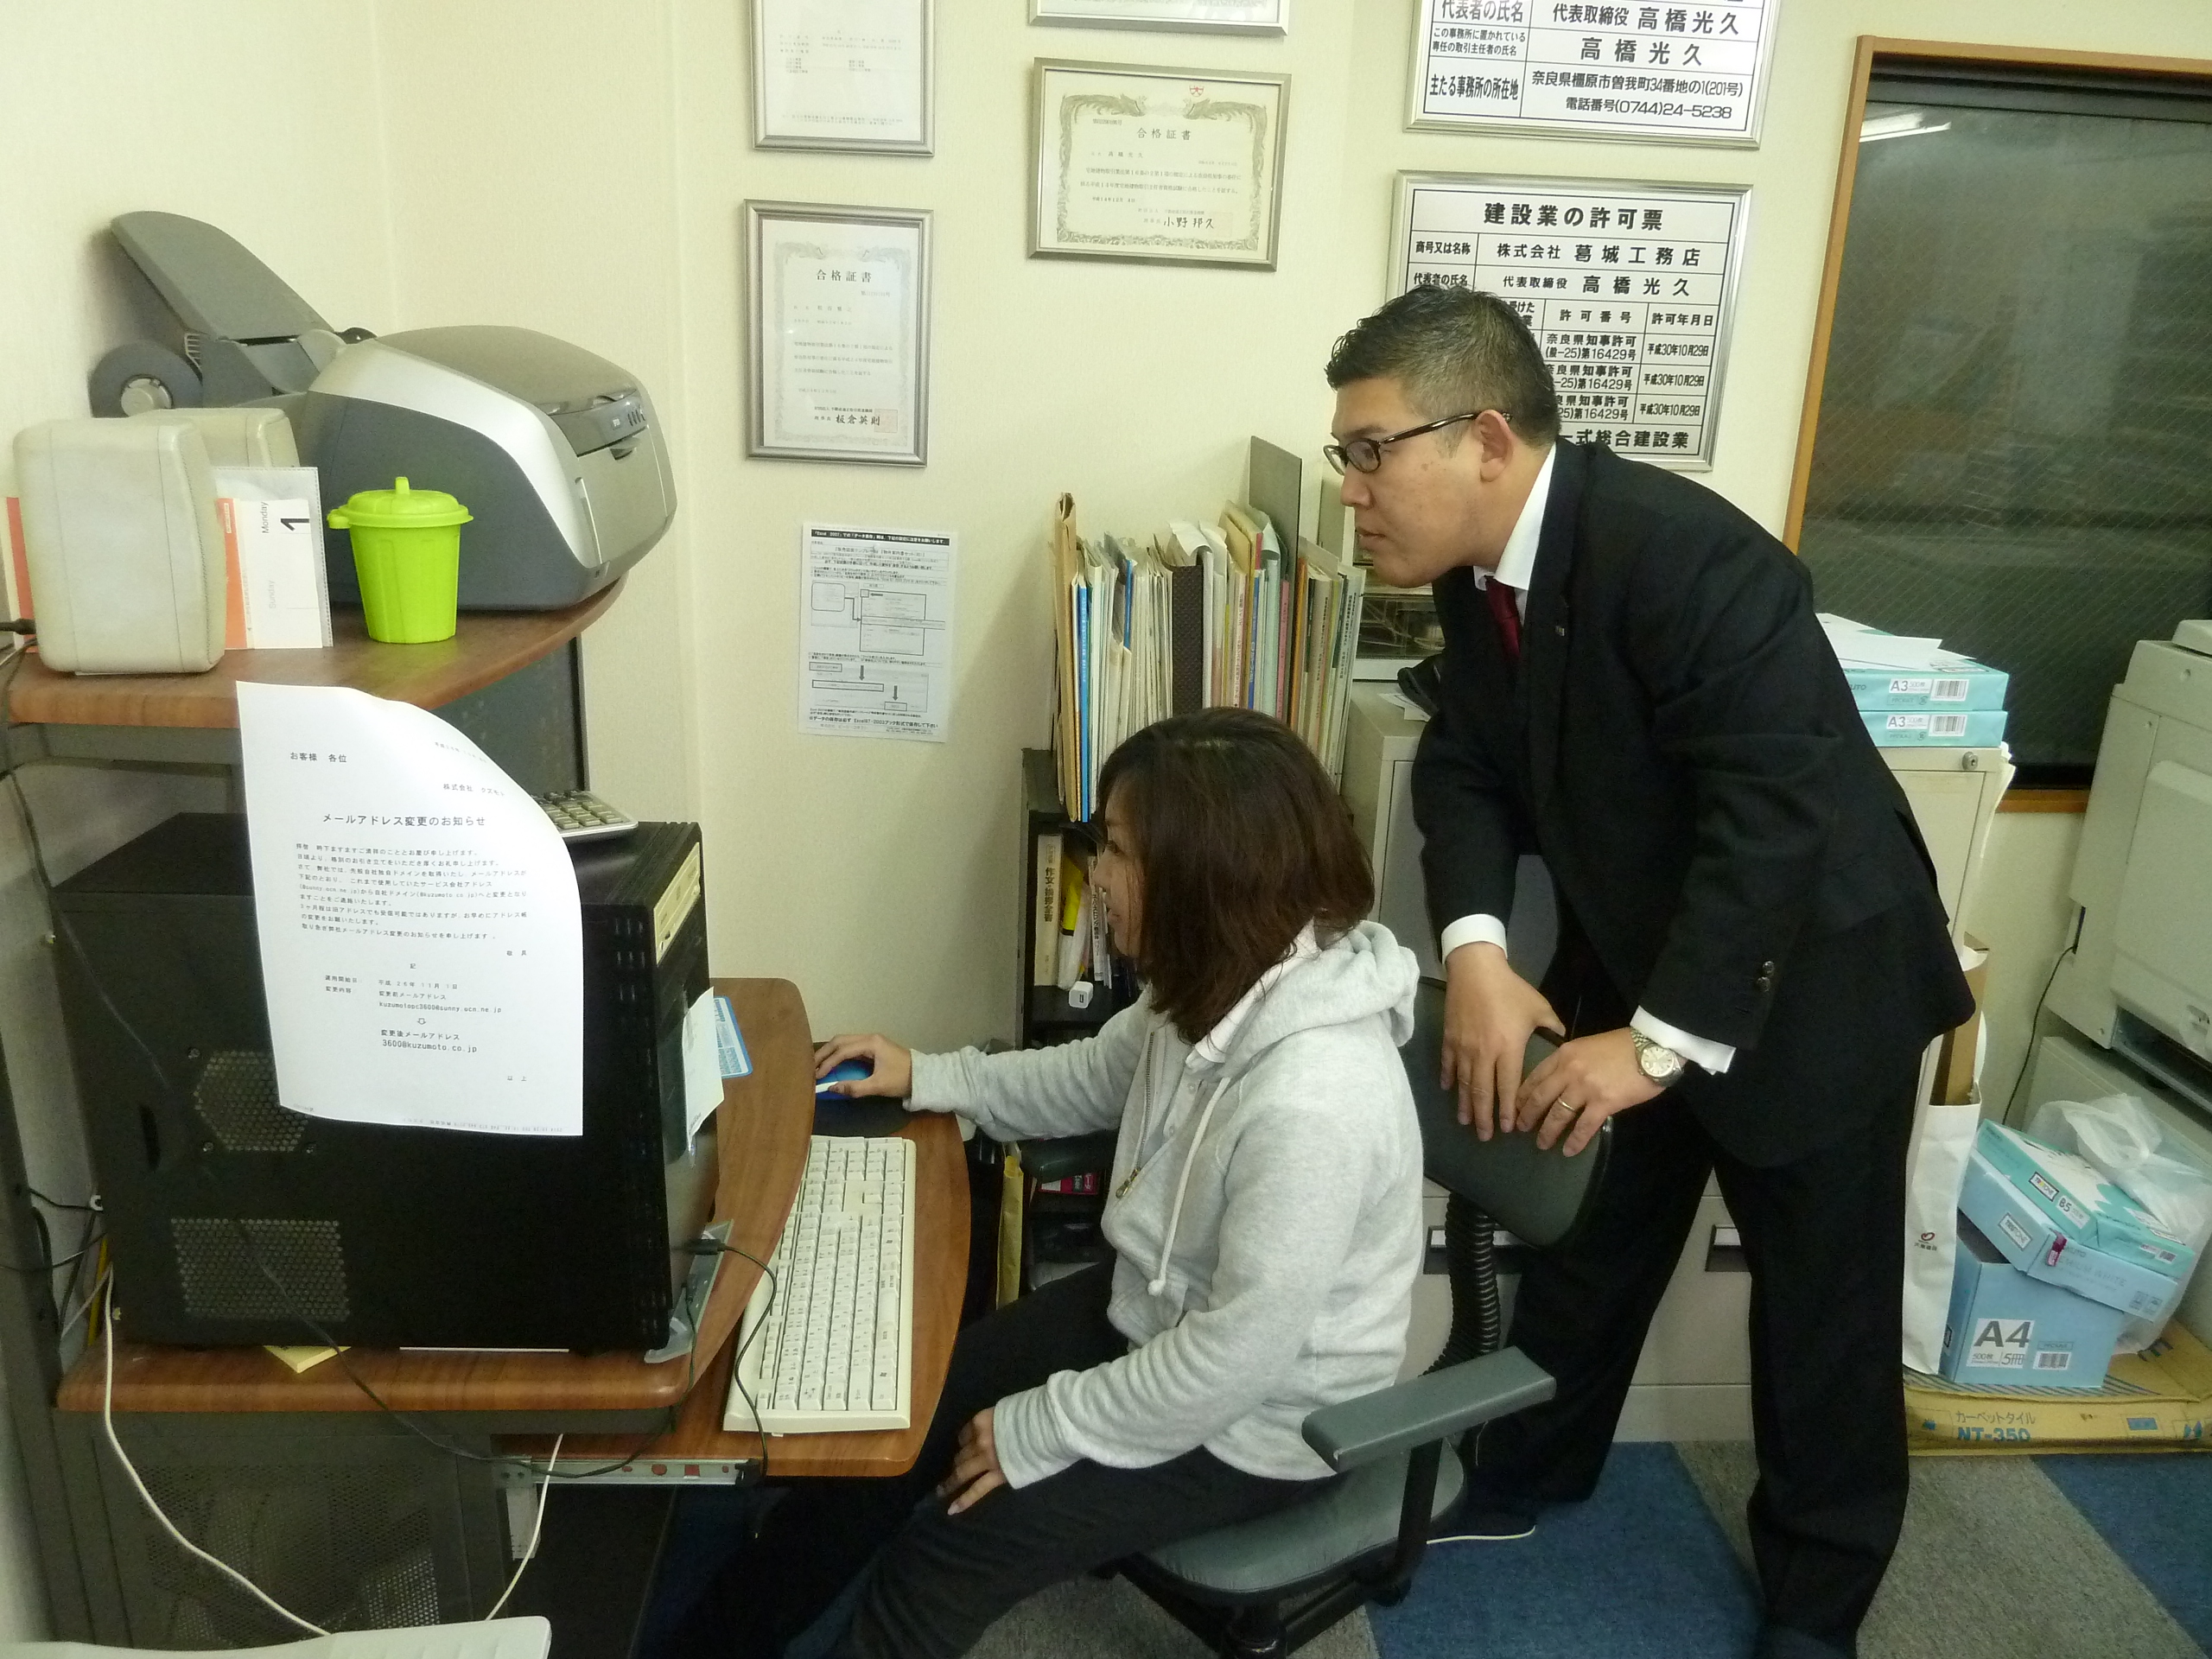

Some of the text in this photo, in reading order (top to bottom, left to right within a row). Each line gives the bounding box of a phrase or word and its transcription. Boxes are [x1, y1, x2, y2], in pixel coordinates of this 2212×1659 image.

[1442, 0, 1523, 22] 代表者の氏名
[1553, 3, 1739, 35] 代表取締役 高橋光久
[1434, 28, 1526, 42] この事務所に置かれている
[1433, 41, 1516, 56] 専任の取引主任者の氏名
[1580, 37, 1702, 66] 高橋光久
[1430, 73, 1519, 100] 主たる事務所の所在地
[1137, 127, 1192, 141] 合格証書
[1484, 202, 1664, 231] 建設業の許可票
[1415, 240, 1471, 255] 商号又は名称
[1497, 243, 1700, 267] 株式会社 葛城工務店
[817, 269, 872, 283] 合格証書
[1414, 272, 1468, 286] 代表者の氏名
[1503, 275, 1691, 297] 代表取締役 高橋光久
[1559, 308, 1631, 324] 許可番号
[1651, 313, 1713, 327] 許可年月日
[1547, 334, 1637, 347] 奈良県知事許可
[1647, 343, 1709, 357] 平成30年10月29日
[1643, 373, 1705, 387] 平成30年10月29日
[1639, 403, 1700, 416] 平成30年10月29日
[260, 501, 270, 534] Monday
[280, 518, 310, 531] 1
[267, 580, 276, 609] Sunday
[1891, 680, 1908, 691] A3
[1888, 716, 1906, 727] A3
[289, 752, 347, 763] お客様 各位
[443, 783, 474, 792] 株式会社
[323, 813, 486, 827] メールアドレス変更のお知らせ
[381, 1028, 460, 1040] 変更後メールアドレス
[382, 1039, 477, 1052] 3600@kuzumoto.co.jp
[2058, 1198, 2072, 1212] B5
[1974, 1320, 2031, 1348] A4
[1955, 1411, 2036, 1424] カーペットタイル
[1958, 1427, 2031, 1441] NT-350
